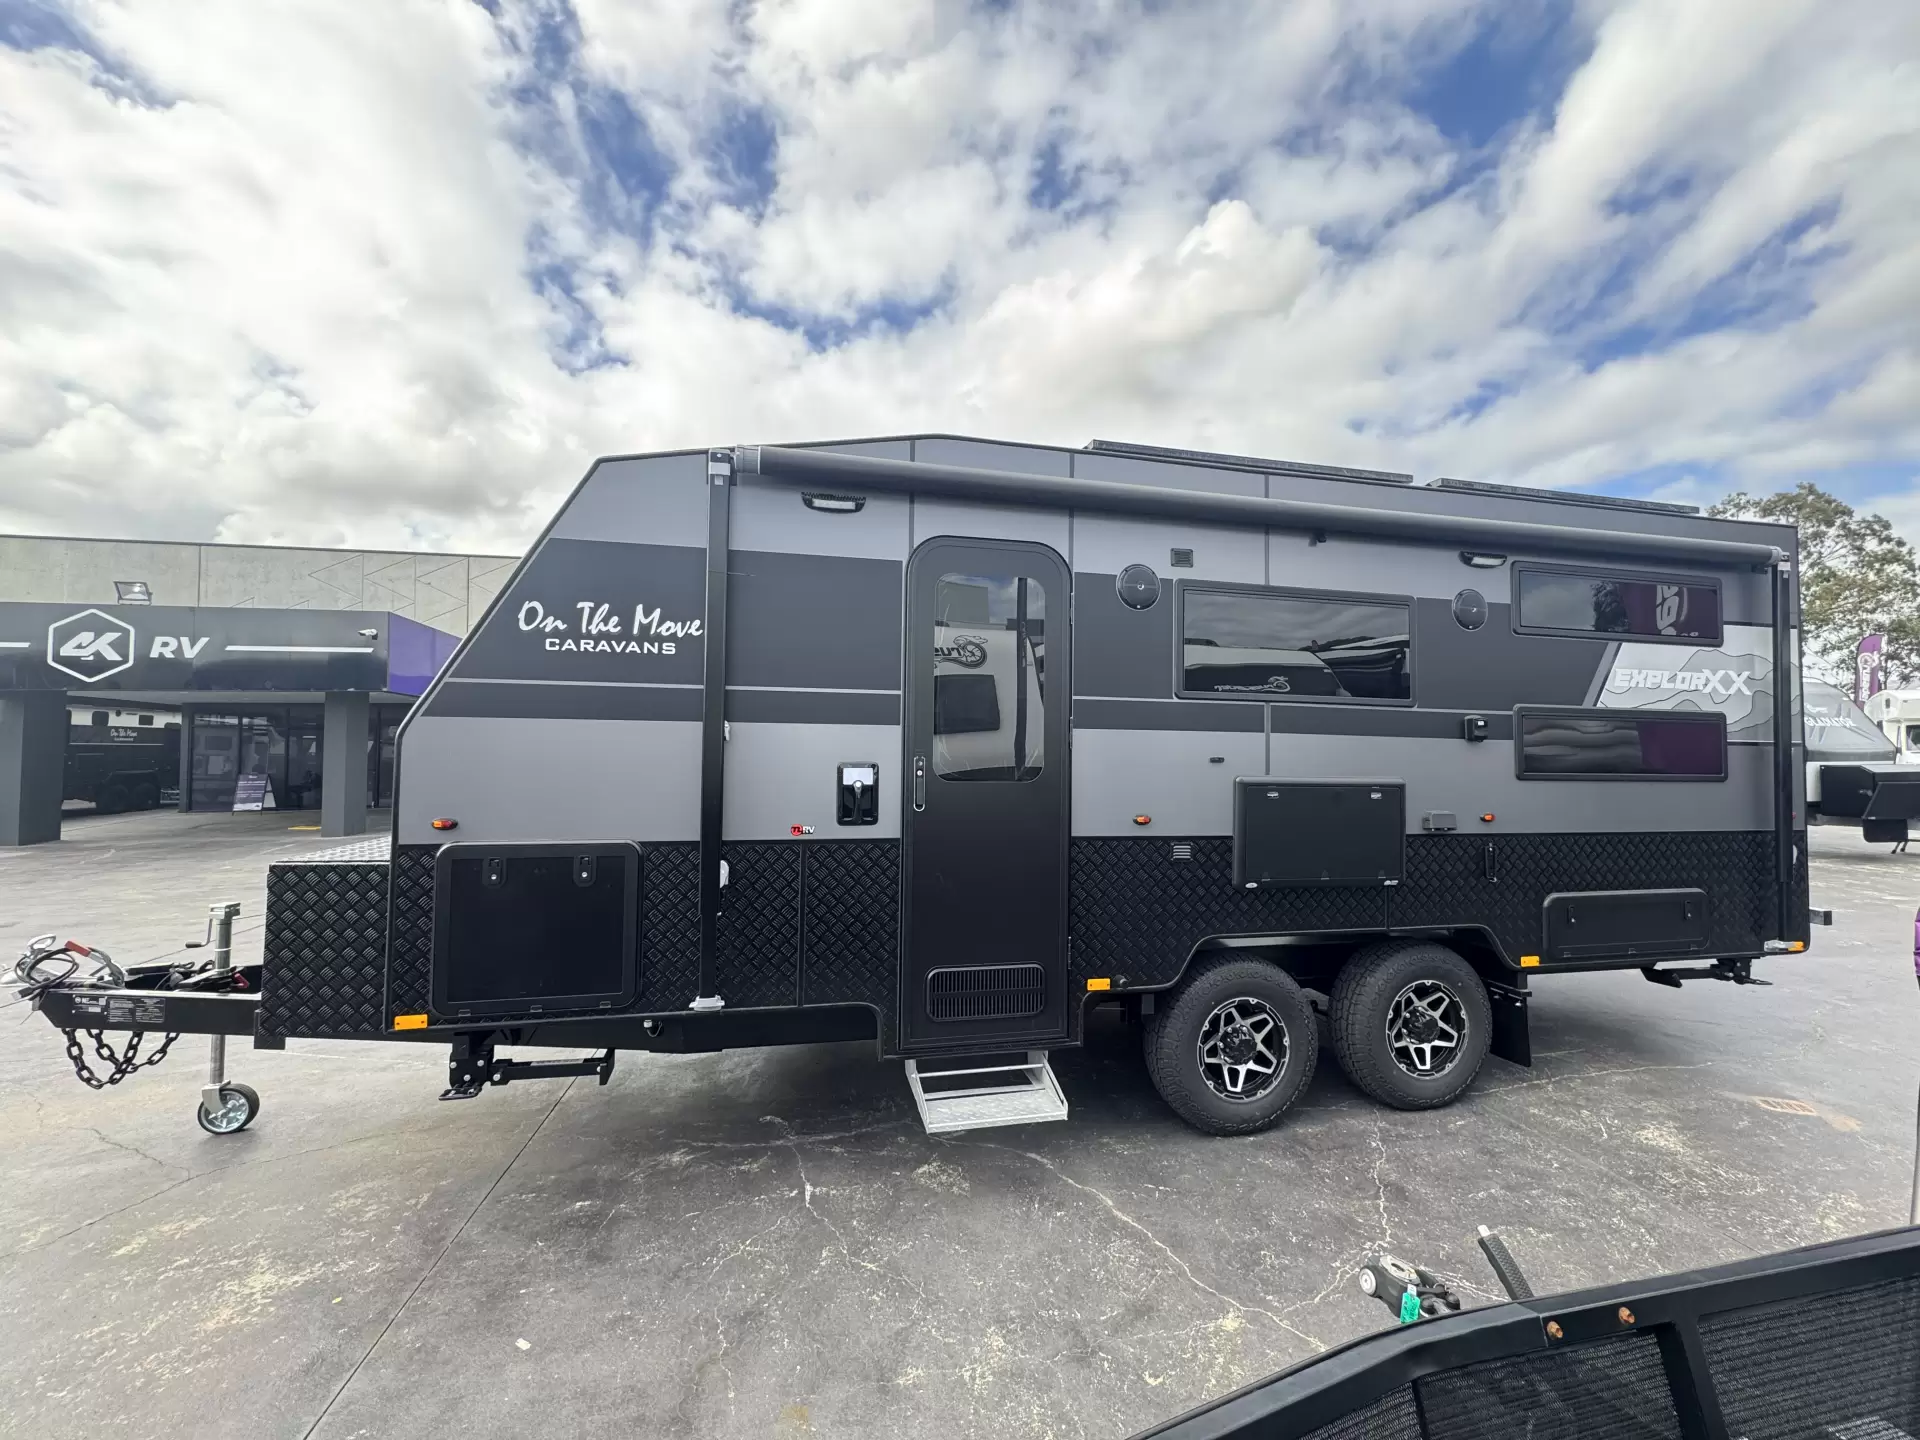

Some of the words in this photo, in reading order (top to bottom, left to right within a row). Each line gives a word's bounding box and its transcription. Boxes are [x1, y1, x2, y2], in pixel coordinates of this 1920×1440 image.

[518, 600, 568, 632] On
[576, 601, 622, 636] The
[632, 603, 704, 638] Move
[60, 631, 123, 661] 4K
[149, 636, 210, 659] RV
[545, 638, 676, 655] CARAVANS
